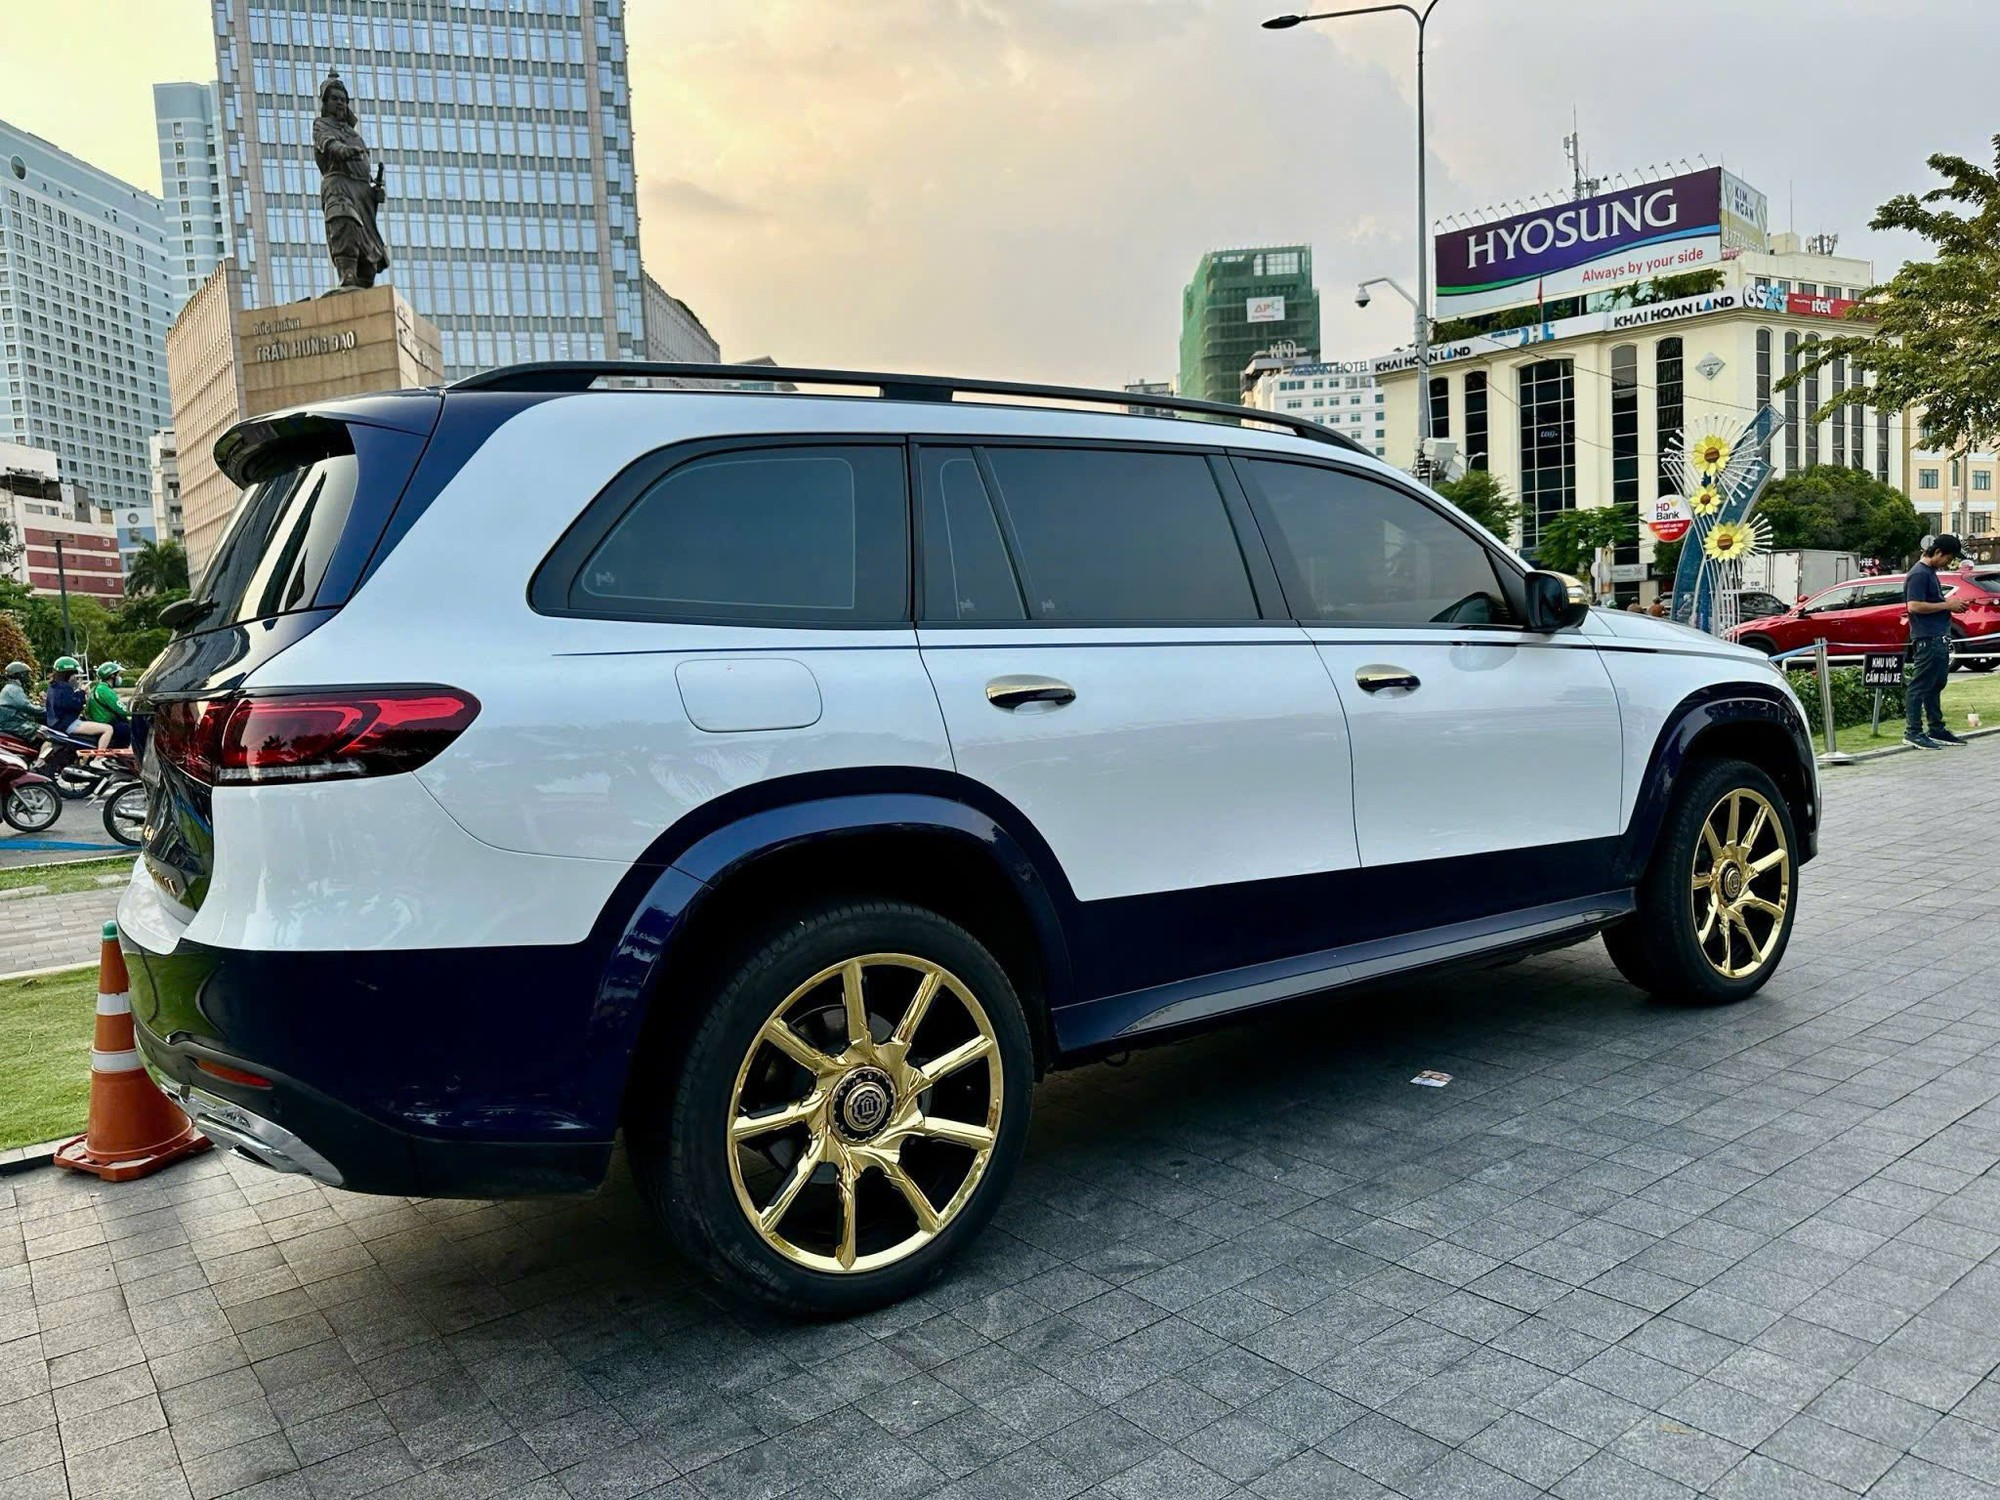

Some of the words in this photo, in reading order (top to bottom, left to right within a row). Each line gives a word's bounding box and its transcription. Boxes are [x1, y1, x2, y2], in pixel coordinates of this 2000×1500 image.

[1734, 185, 1748, 204] KIM
[1467, 188, 1678, 269] HYOSUNG
[1582, 266, 1625, 283] Always
[1628, 261, 1643, 277] by
[1646, 256, 1674, 272] your
[1678, 248, 1704, 263] side
[1743, 284, 1786, 313] GS25
[1811, 298, 1834, 315] itel
[1614, 311, 1648, 328] KHAI
[1651, 303, 1692, 321] HOAN
[1696, 296, 1734, 313] LAND
[257, 338, 288, 362] TRẦN
[292, 336, 329, 358] HƯNG
[331, 330, 356, 354] ĐẠO
[1336, 361, 1369, 374] HOTEL
[1375, 356, 1403, 372] KHAI
[1404, 351, 1438, 367] HON
[1440, 346, 1471, 361] LAND
[1656, 502, 1670, 511] HD
[1656, 511, 1679, 520] Bank
[1872, 657, 1884, 668] KHU
[1886, 656, 1898, 670] VỰC
[1865, 670, 1879, 683] CẤM
[1893, 673, 1901, 682] XE
